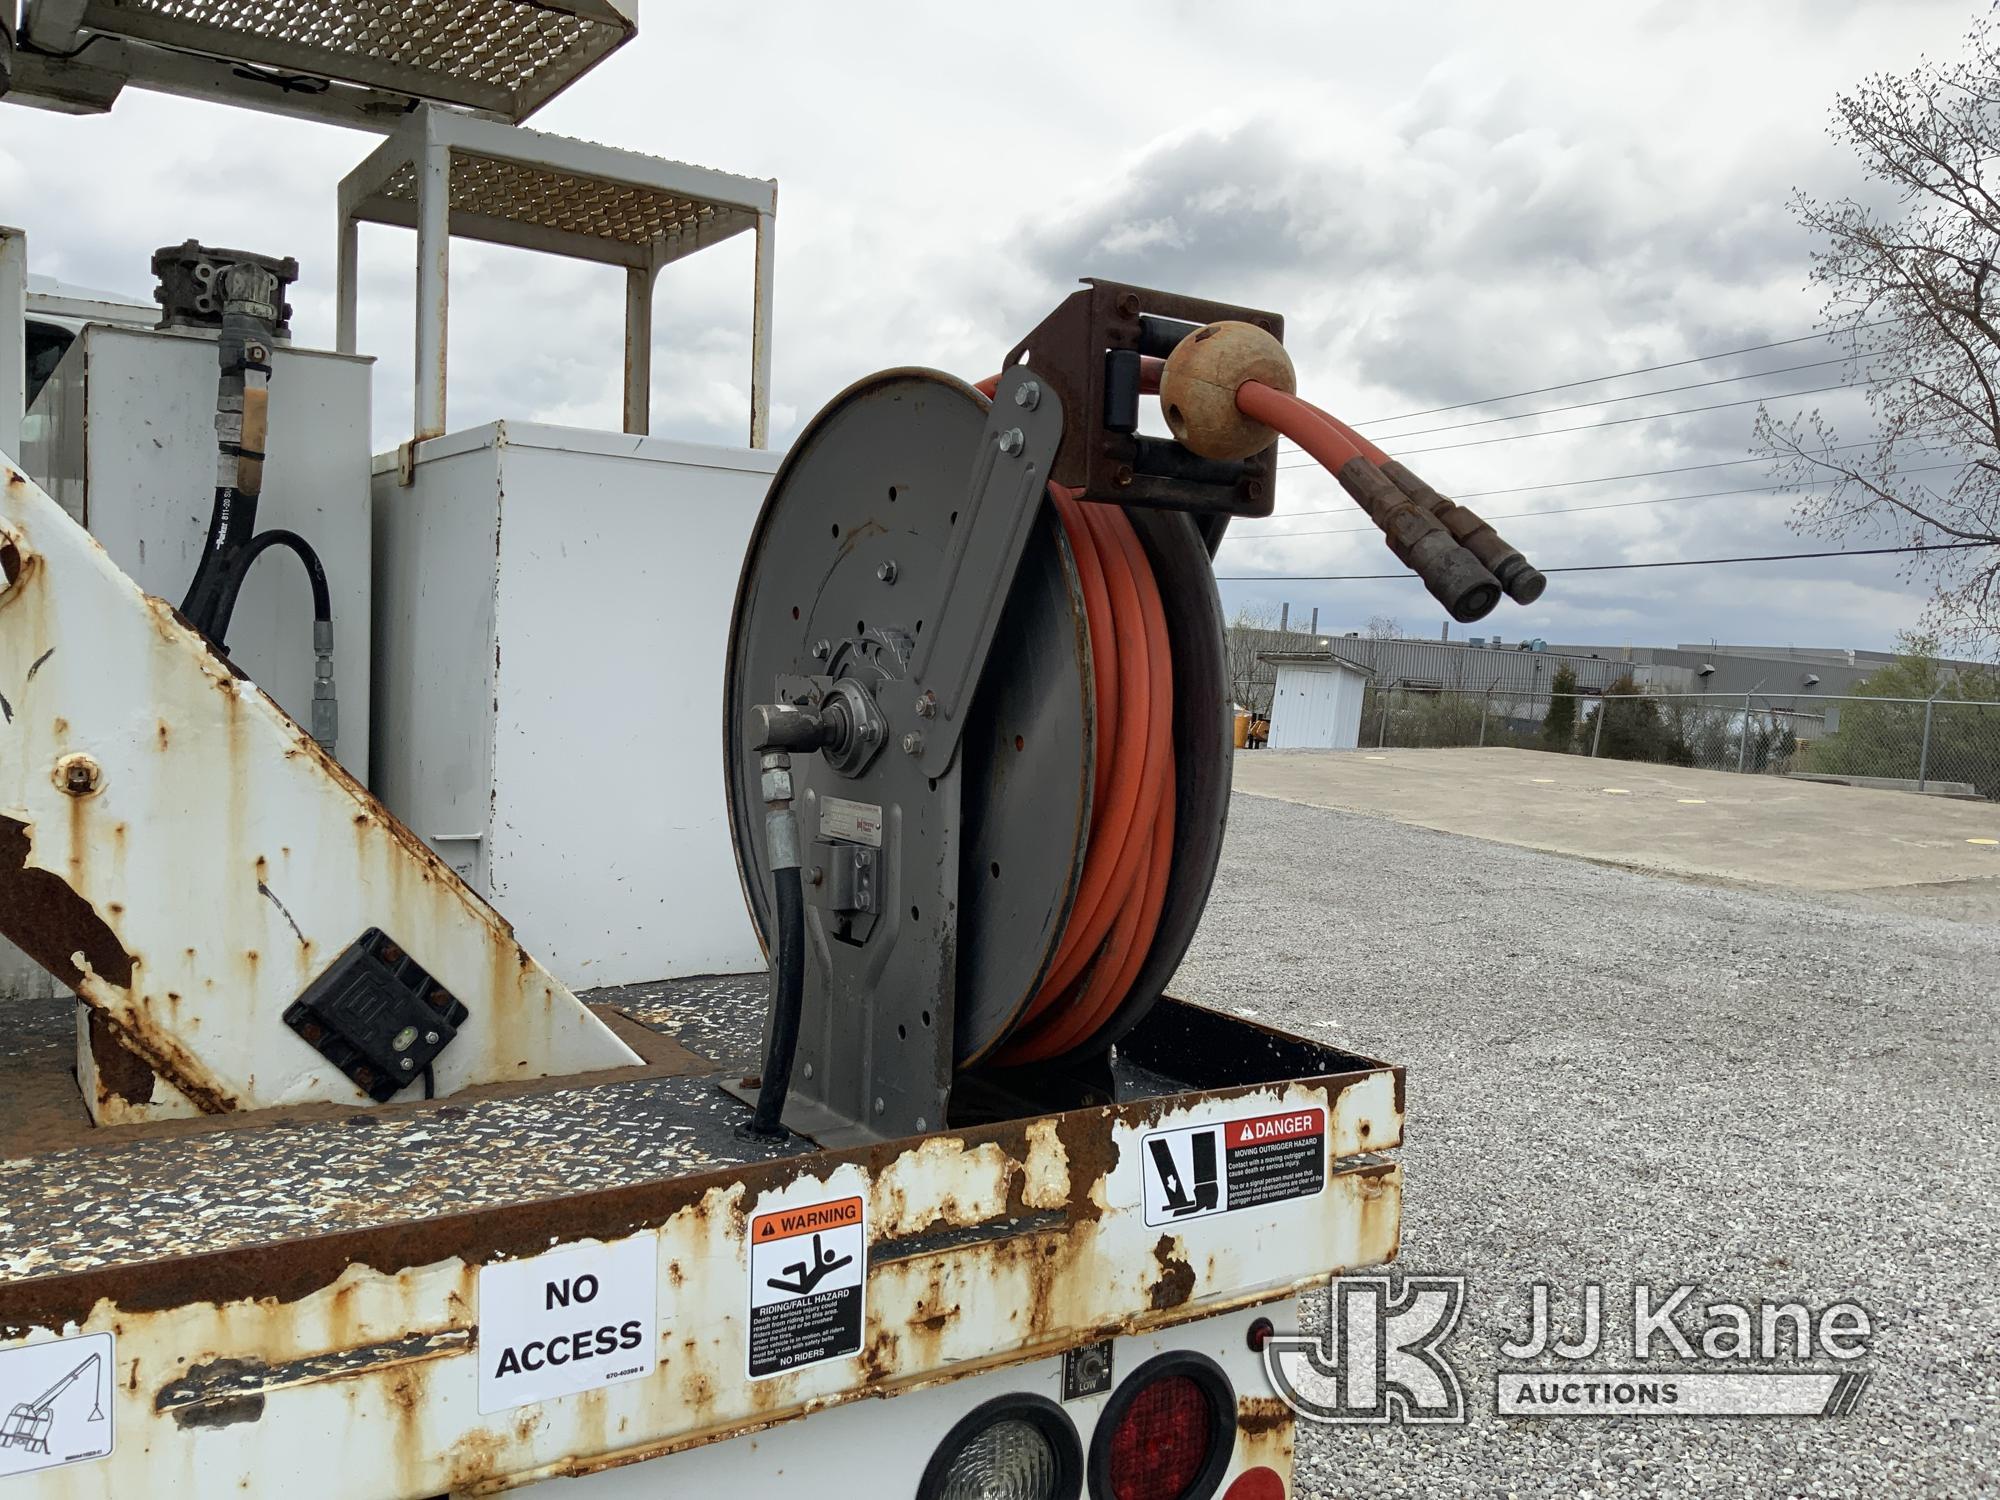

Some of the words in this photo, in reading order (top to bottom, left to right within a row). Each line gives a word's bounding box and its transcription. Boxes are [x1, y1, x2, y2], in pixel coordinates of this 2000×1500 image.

[221, 498, 231, 520] 811-20
[1256, 1115, 1312, 1138] DANGER
[1235, 1148, 1258, 1157] MOVING
[1259, 1141, 1293, 1153] OUTRIGGER
[1294, 1138, 1317, 1147] HAZARD
[1228, 1161, 1248, 1169] Contact
[1265, 1155, 1283, 1163] moving
[1284, 1151, 1306, 1160] outrigger
[1266, 1162, 1284, 1170] serious
[1229, 1190, 1252, 1199] personnel
[1263, 1182, 1290, 1192] obstructions
[1250, 1179, 1264, 1187] signal
[1265, 1176, 1281, 1184] person
[1229, 1197, 1251, 1205] outrigger
[1269, 1189, 1286, 1197] contact
[781, 1205, 856, 1232] WARNING
[546, 1274, 599, 1310] NO
[760, 1298, 813, 1316] RIDING/FALL
[815, 1289, 849, 1304] HAZARD
[753, 1317, 771, 1325] Death
[780, 1310, 802, 1319] serious
[803, 1305, 819, 1314] injury
[821, 1301, 837, 1309] could
[753, 1324, 770, 1332] result
[787, 1317, 804, 1325] riding
[753, 1331, 771, 1339] Riders
[812, 1316, 833, 1325] crushed
[495, 1321, 642, 1378] ACCESS
[753, 1338, 769, 1346] under
[753, 1351, 766, 1359] must
[805, 1339, 820, 1348] safety
[770, 1340, 789, 1348] vehicle
[780, 1357, 792, 1366] NO
[794, 1348, 824, 1362] RIDERS
[1079, 1379, 1097, 1391] LOW
